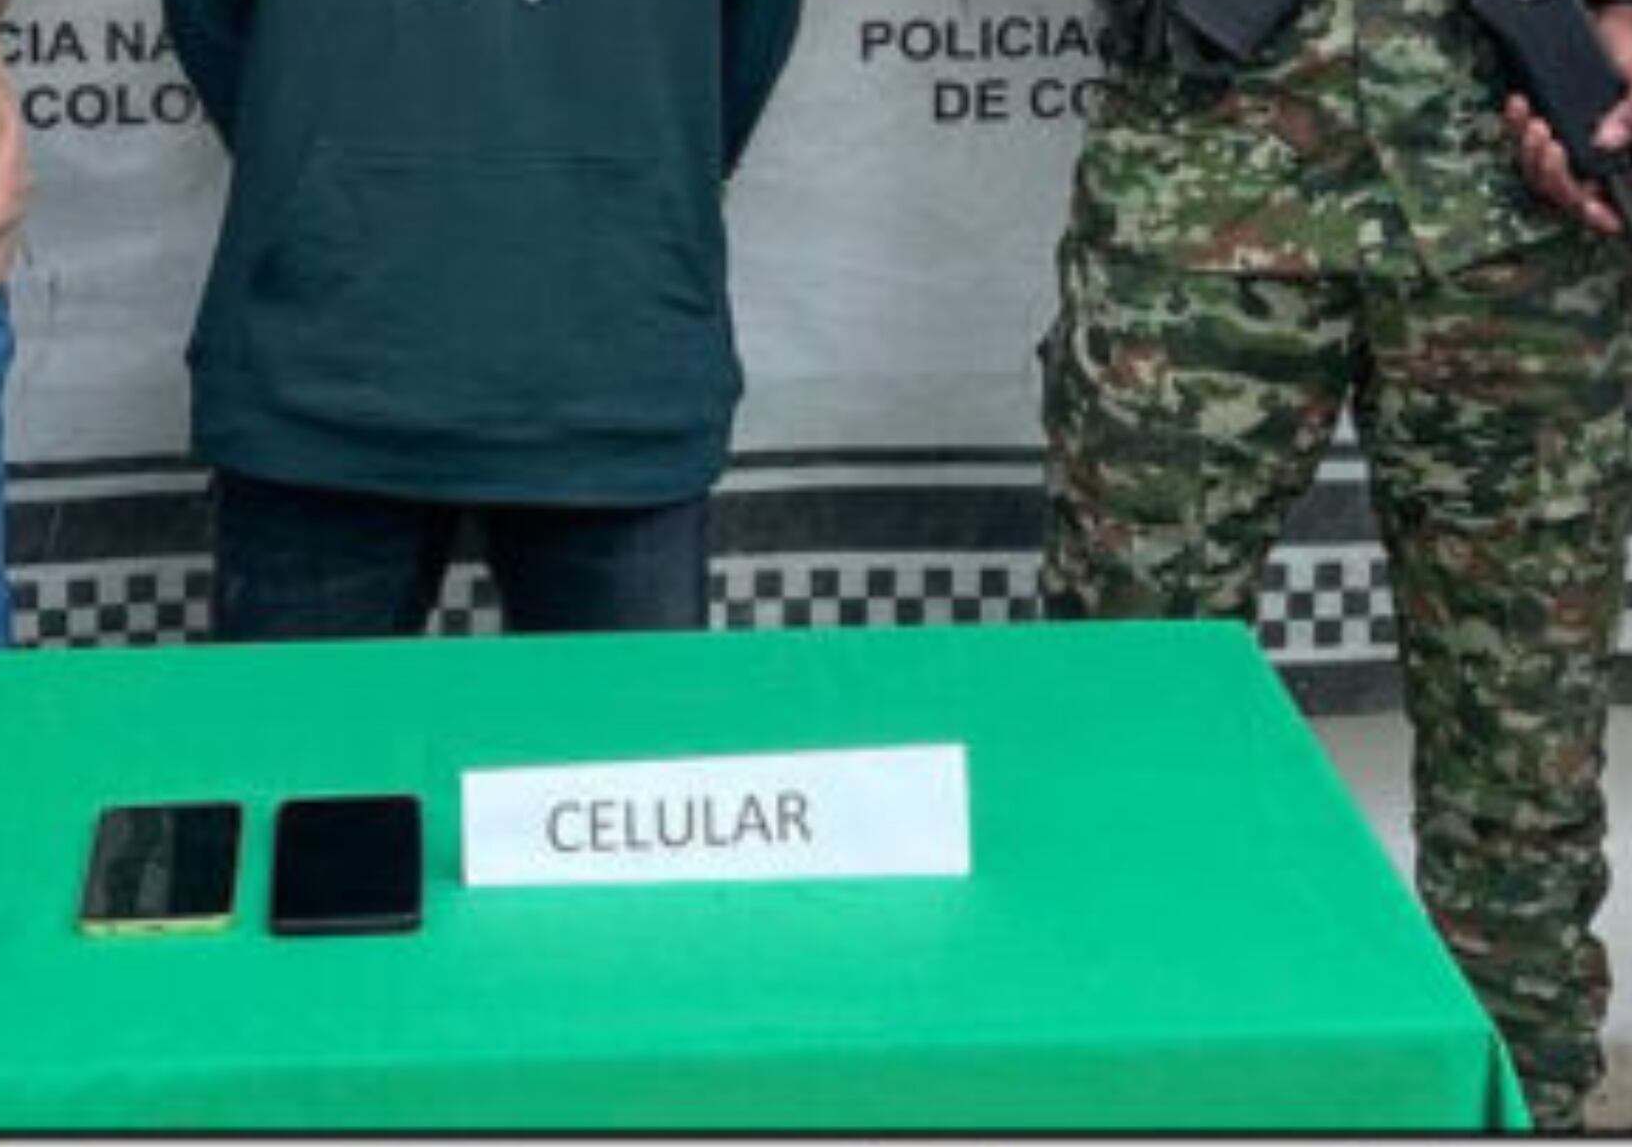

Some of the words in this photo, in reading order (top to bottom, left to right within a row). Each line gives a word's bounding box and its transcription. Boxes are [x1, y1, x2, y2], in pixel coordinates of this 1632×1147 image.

[859, 14, 1090, 63] POLICIA
[933, 78, 1011, 125] DE
[545, 790, 812, 853] CELULAR
